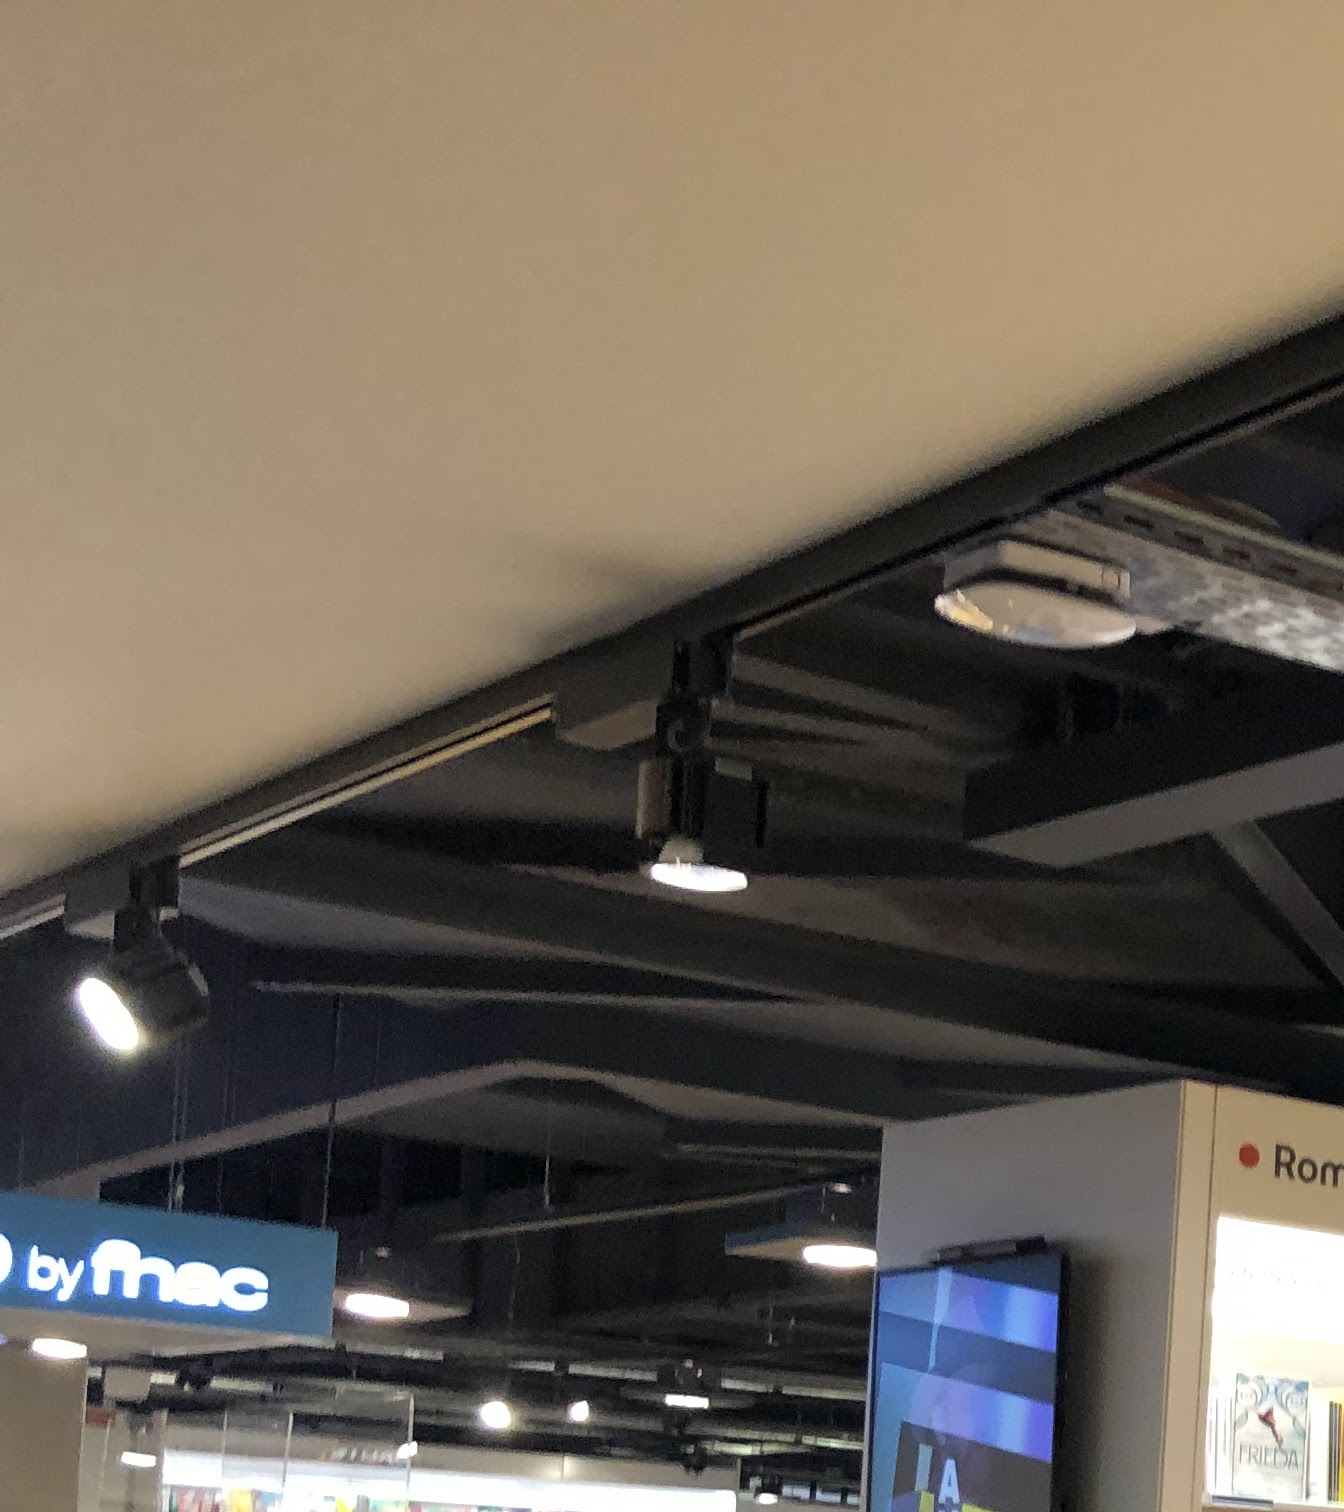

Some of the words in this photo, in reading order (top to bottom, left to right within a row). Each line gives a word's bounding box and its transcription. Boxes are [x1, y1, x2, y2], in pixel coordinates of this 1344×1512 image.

[28, 1244, 85, 1302] by
[91, 1238, 269, 1311] fnac
[1239, 1443, 1300, 1470] FRIEDA
